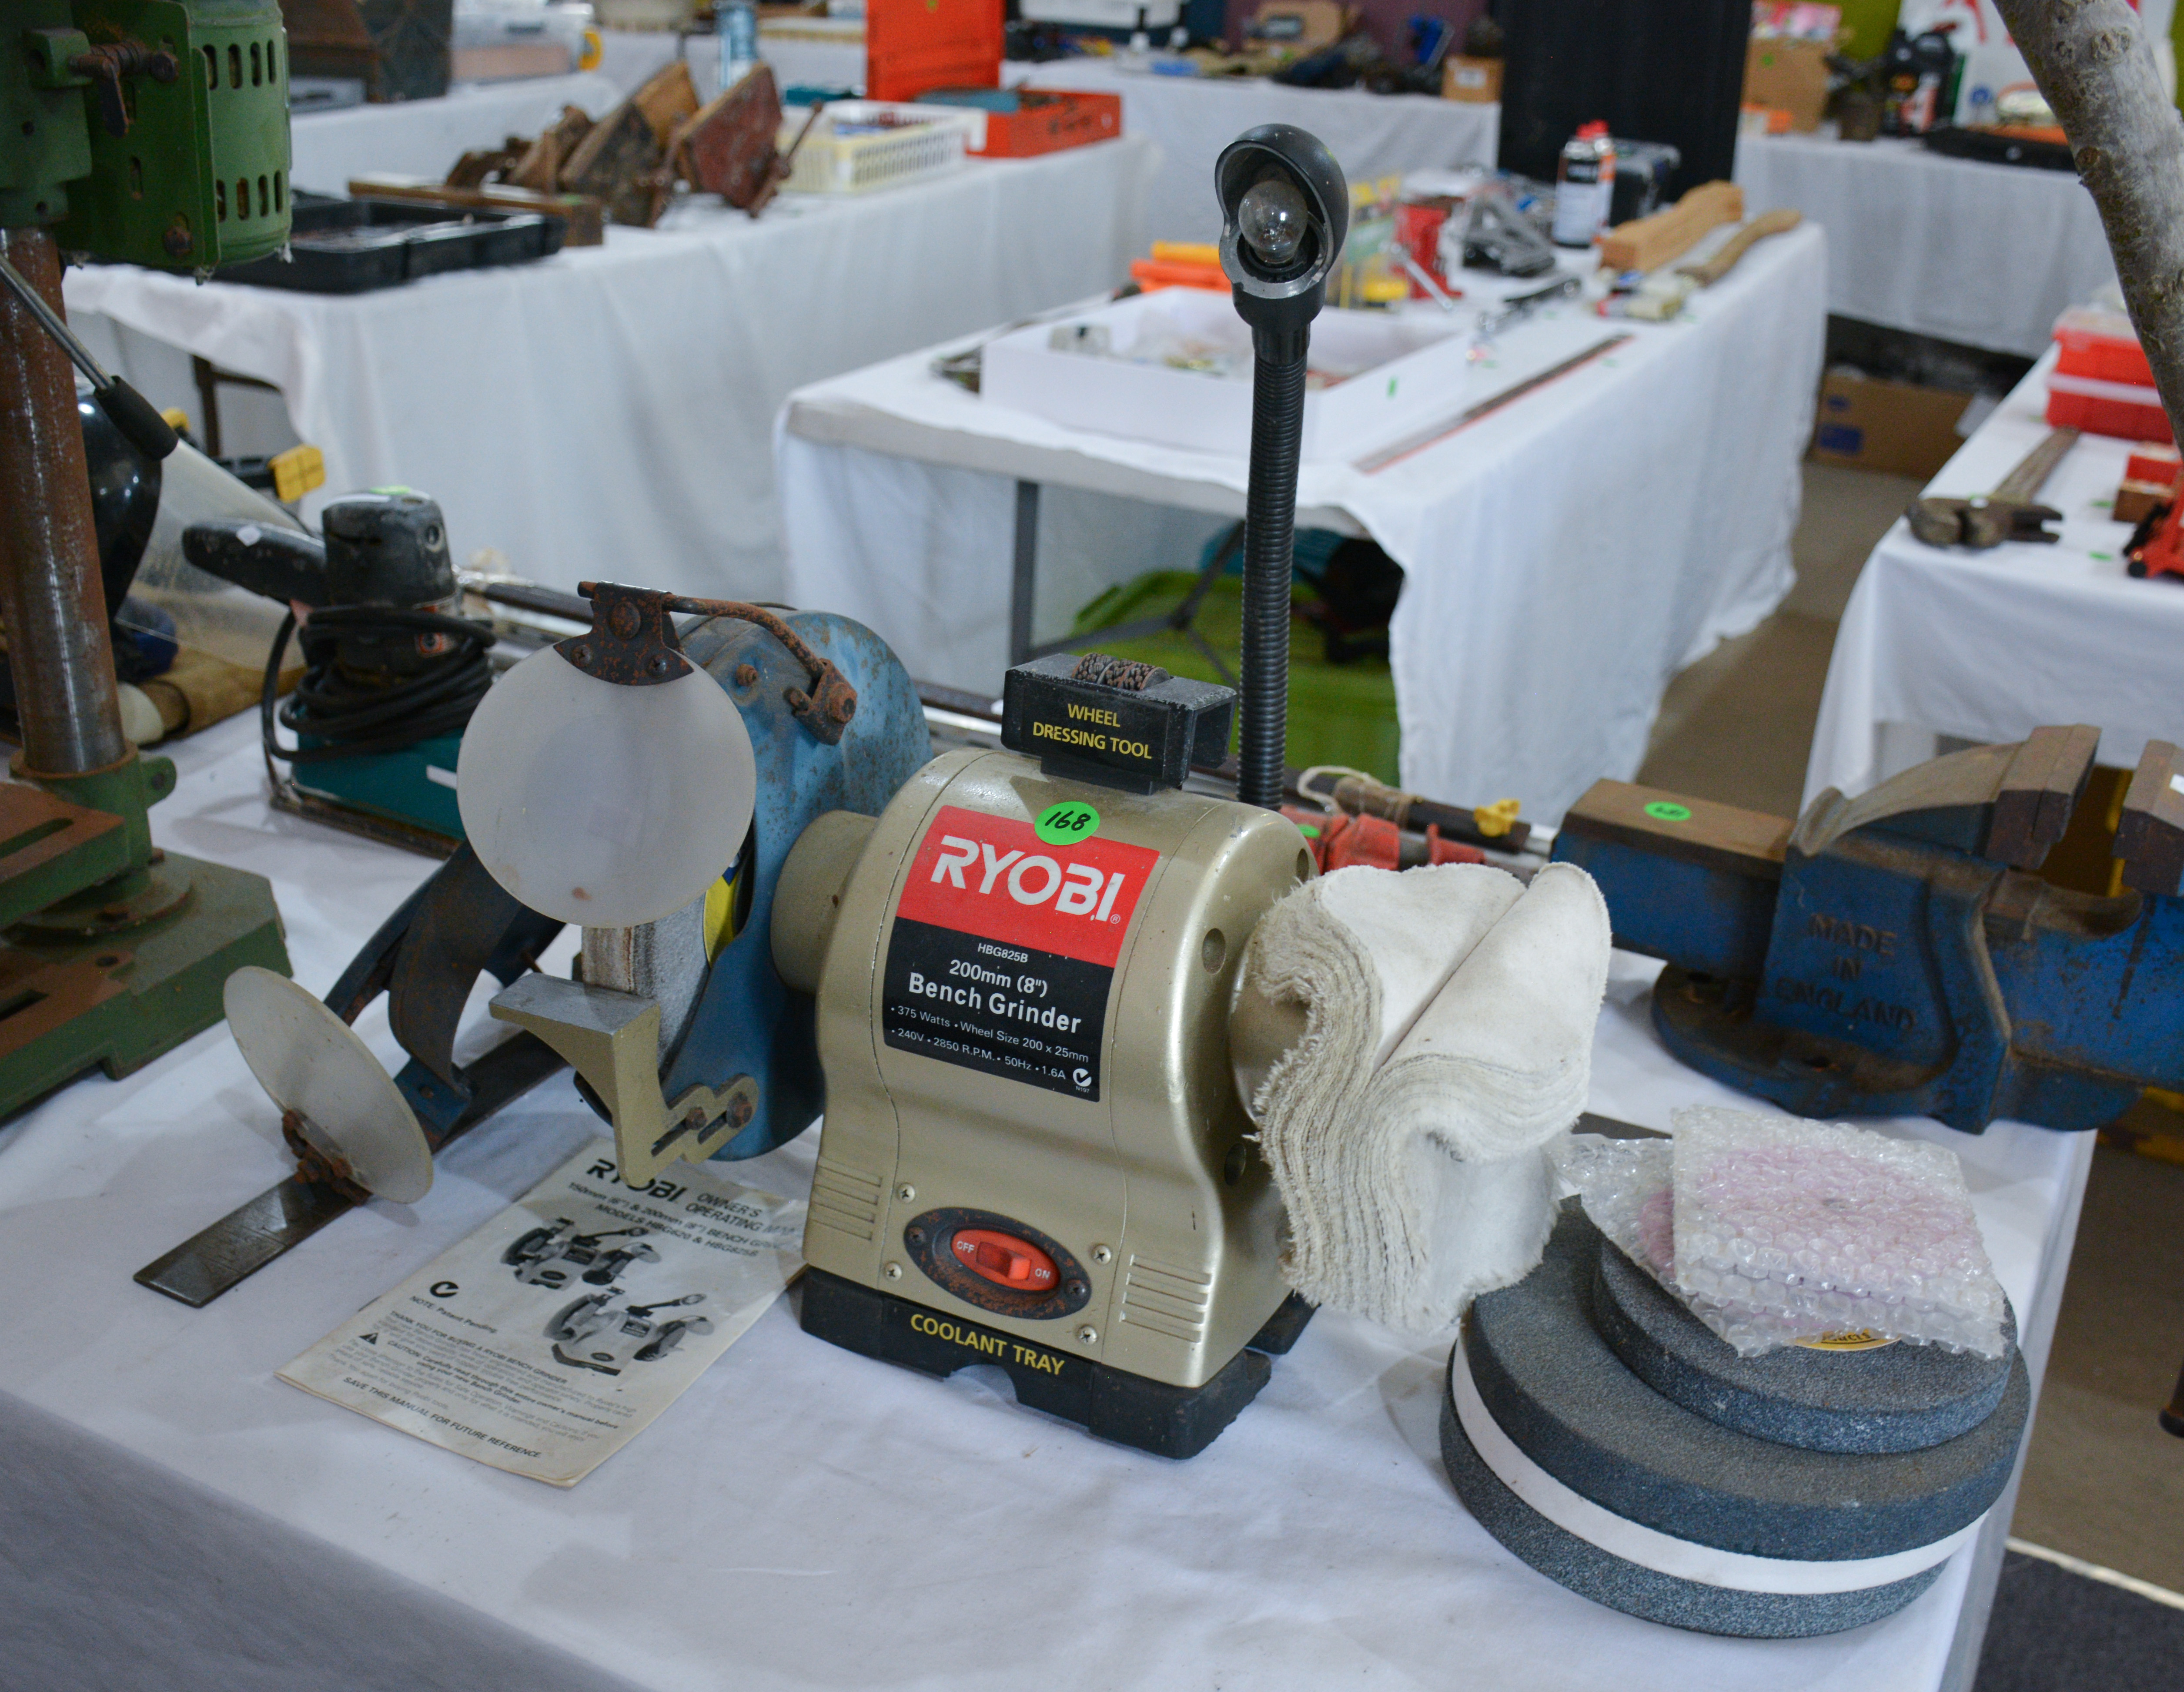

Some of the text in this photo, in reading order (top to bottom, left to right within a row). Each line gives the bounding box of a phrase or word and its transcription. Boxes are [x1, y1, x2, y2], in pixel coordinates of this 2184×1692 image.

[1067, 703, 1120, 727] WHEEL
[1033, 722, 1152, 759] DRESSING TOOL
[1045, 811, 1091, 831] 168
[930, 835, 1125, 921] RYOBI
[977, 943, 1028, 963] HBG825B
[1809, 913, 1896, 956] MADE
[949, 959, 1047, 998] 200mm (8")
[1832, 955, 1863, 982] IN
[909, 972, 1082, 1033] Bench Grinder
[1775, 976, 1915, 1030] ENGLAND
[898, 1006, 916, 1018] 375
[920, 1011, 950, 1027] Watts
[960, 1021, 993, 1038] Wheel
[997, 1031, 1019, 1044] Size
[1023, 1038, 1042, 1051] 200
[1055, 1046, 1089, 1062] 25mm
[898, 1028, 1066, 1079] 240V 2850 R.P.M. 50Hz 1.6A
[686, 1203, 763, 1231] OPERATING
[957, 1241, 975, 1253] OFF
[1035, 1268, 1050, 1280] ON
[911, 1314, 1065, 1375] COOLANT TRAY
[342, 1376, 369, 1389] SAVE
[368, 1387, 390, 1398] THIS
[388, 1396, 430, 1415] MANUAL
[430, 1414, 451, 1424] FOR
[449, 1422, 488, 1439] FUTURE
